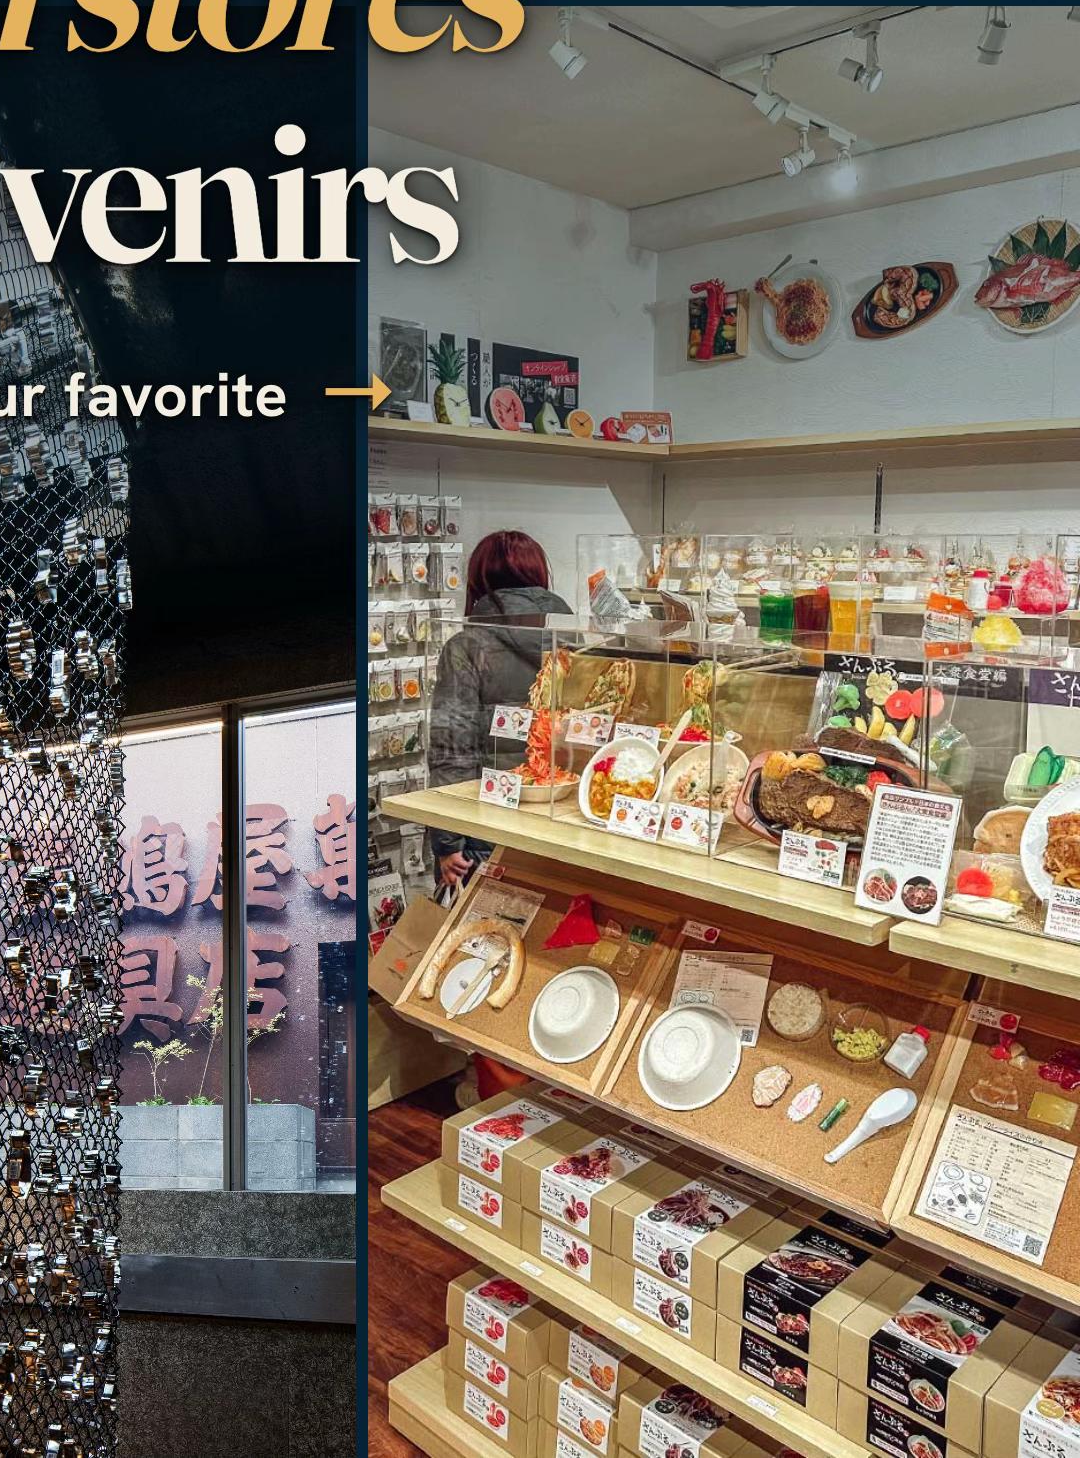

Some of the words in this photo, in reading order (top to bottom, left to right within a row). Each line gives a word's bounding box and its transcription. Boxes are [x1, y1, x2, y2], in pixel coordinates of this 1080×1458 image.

[935, 665, 1008, 683] 大衆食堂編
